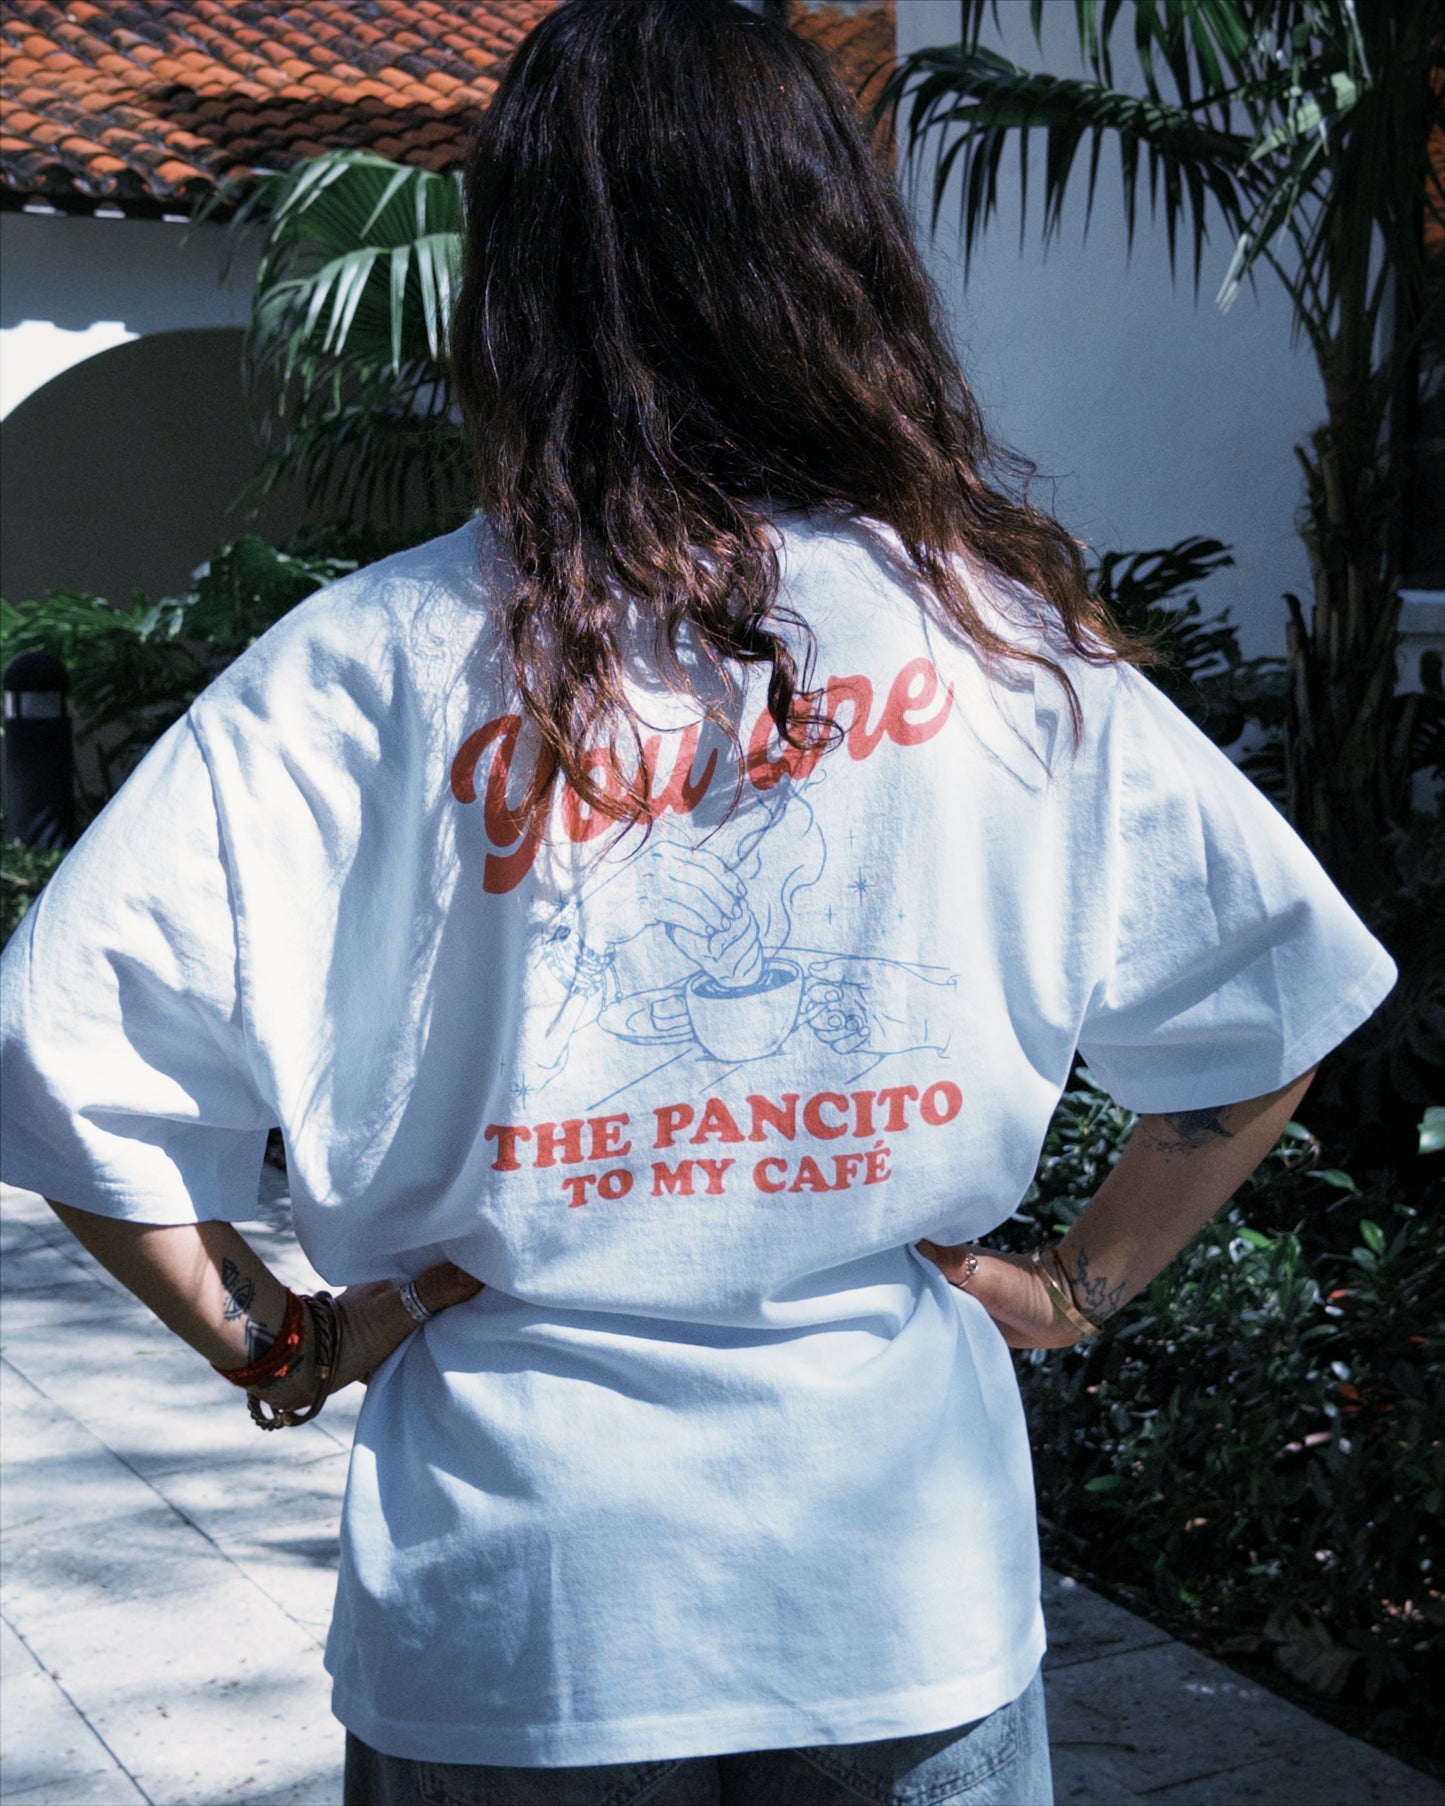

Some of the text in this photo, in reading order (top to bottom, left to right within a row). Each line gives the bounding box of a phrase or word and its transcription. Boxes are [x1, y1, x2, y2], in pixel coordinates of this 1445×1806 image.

[450, 657, 954, 894] You are
[484, 1080, 963, 1172] THE PANCITO
[561, 1140, 893, 1208] TO MY CAFÉ
